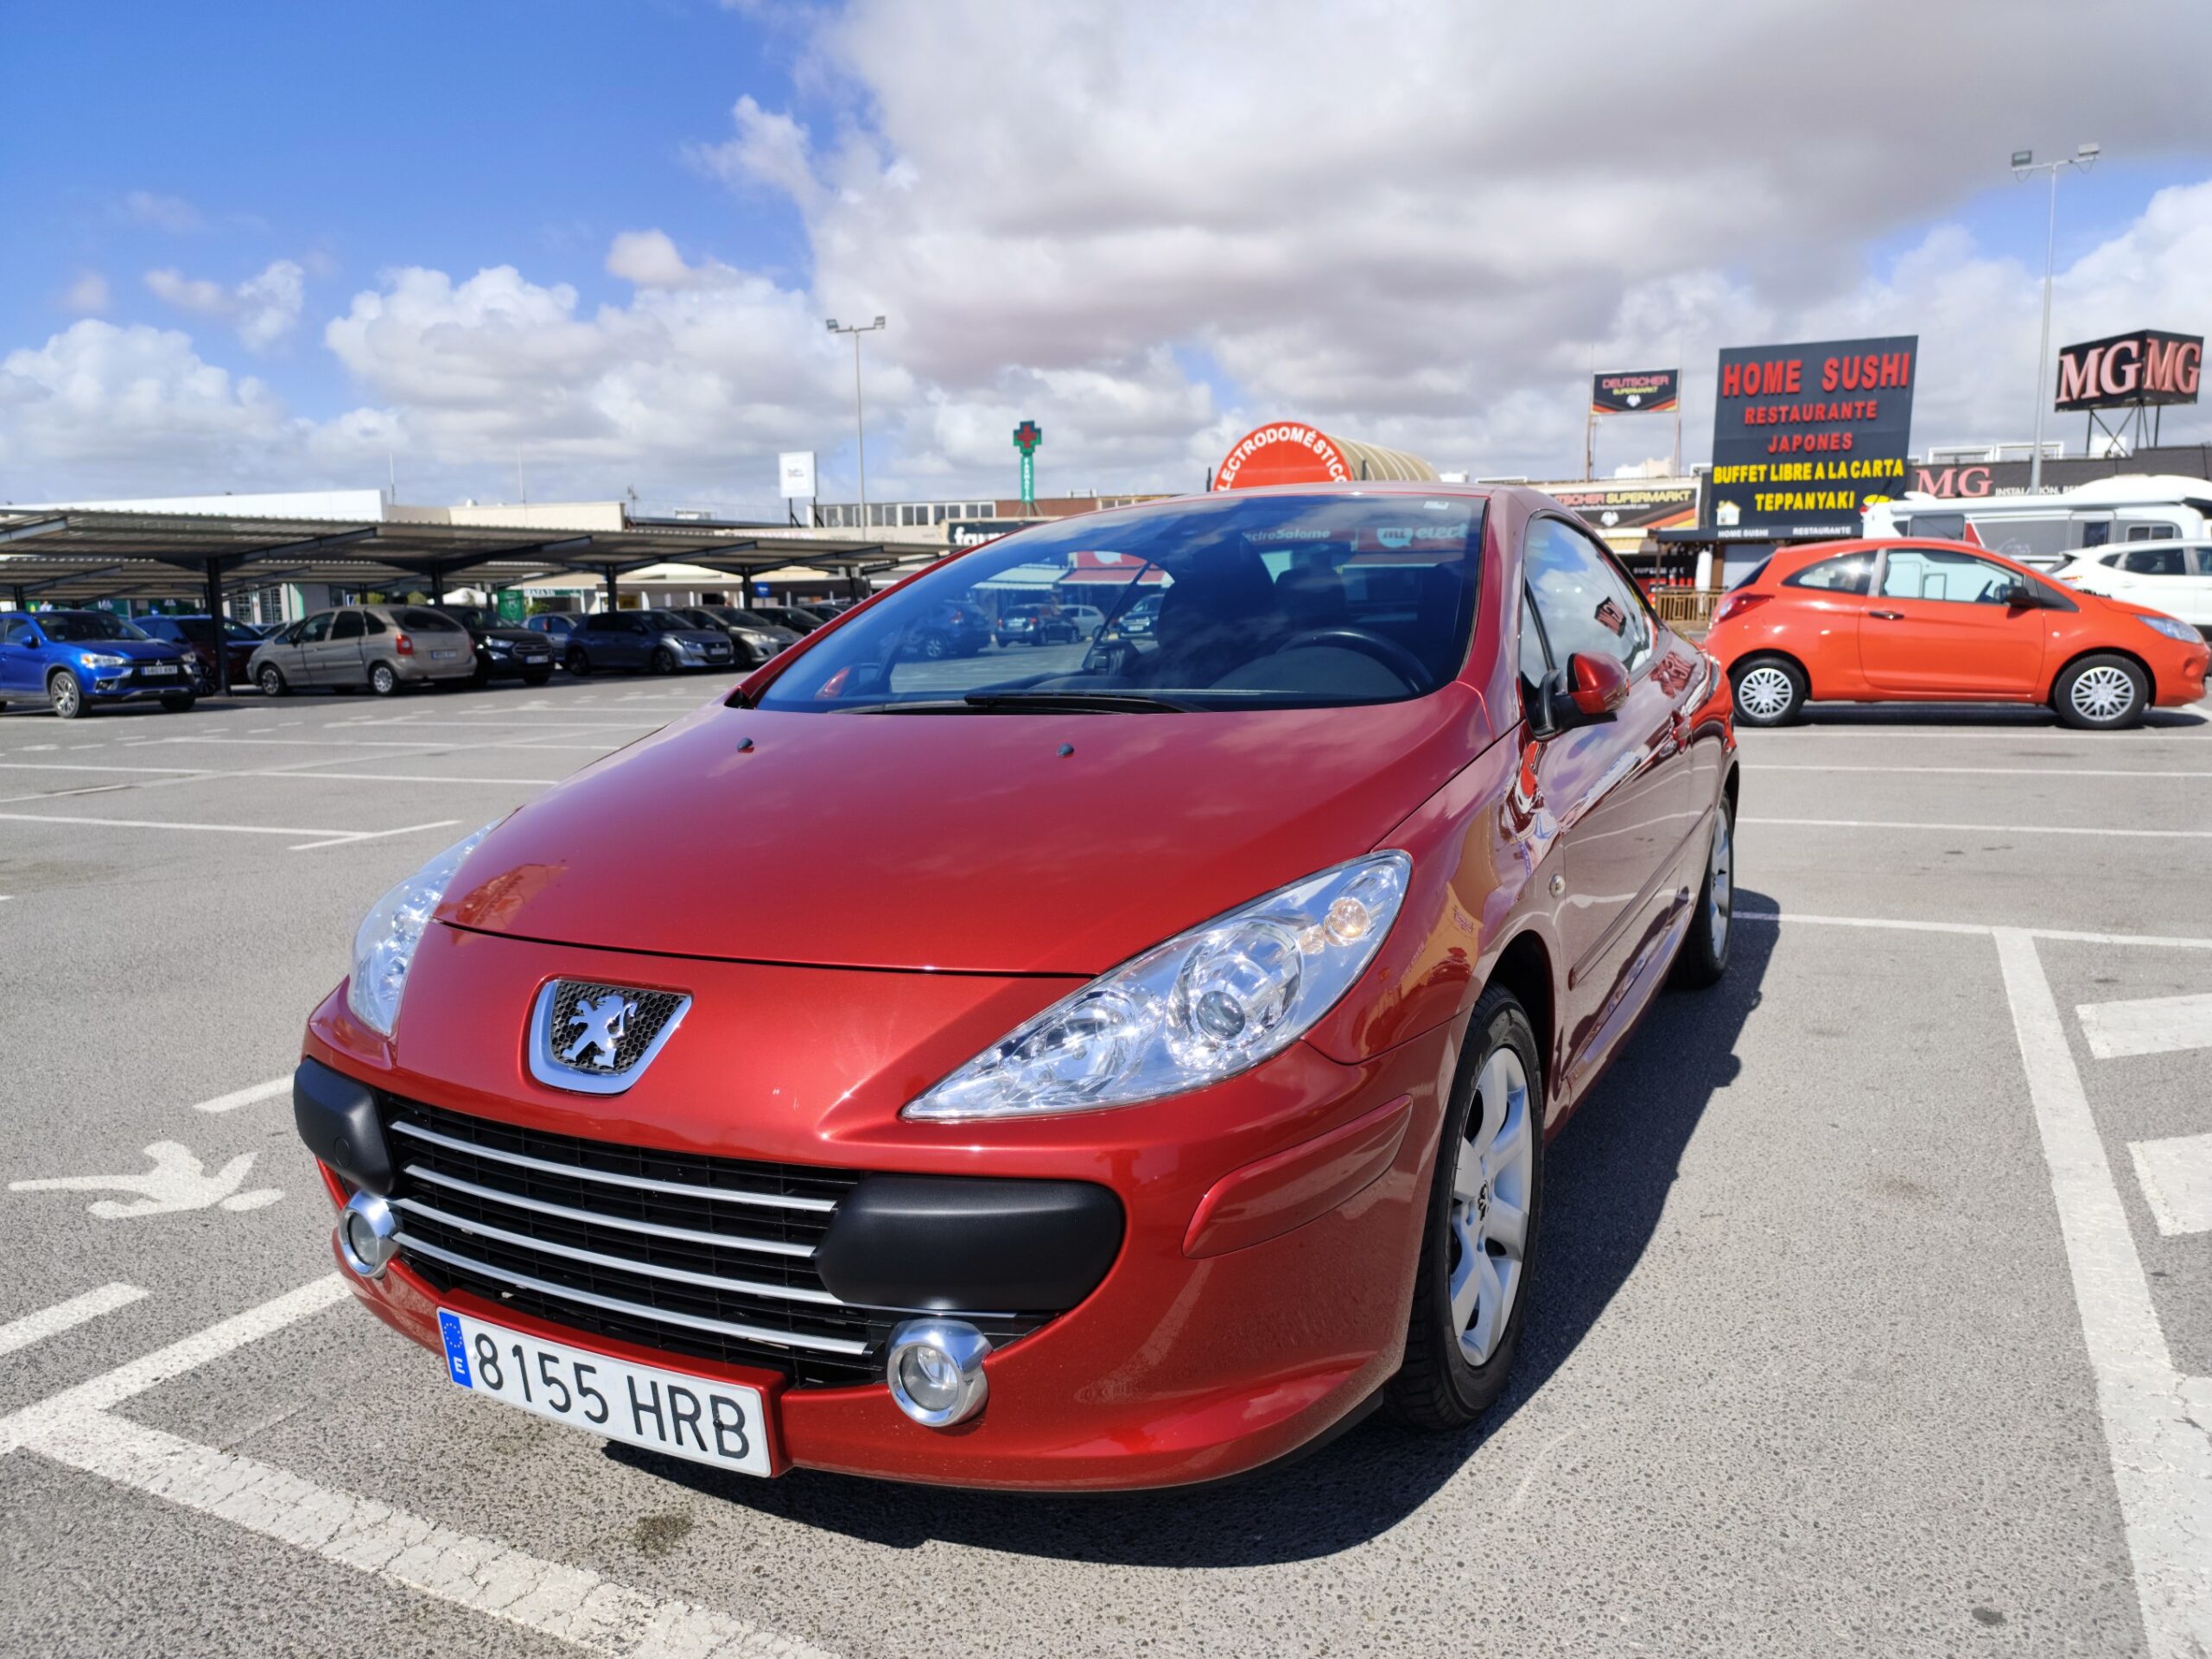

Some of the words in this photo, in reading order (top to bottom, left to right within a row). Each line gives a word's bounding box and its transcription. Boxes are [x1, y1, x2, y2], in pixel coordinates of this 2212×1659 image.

[1722, 359, 1802, 397] HOME
[1821, 353, 1910, 391] SUSHI
[2056, 340, 2142, 404] MG
[2144, 338, 2201, 394] MG
[1602, 375, 1669, 389] DEUTSCHER
[1744, 400, 1878, 425] RESTAURANTE
[1767, 432, 1853, 454] JAPONES
[1217, 426, 1348, 492] LECTRODOMÉSTICO
[1713, 464, 1768, 485] BUFFET
[1770, 461, 1813, 481] LIBRE
[1814, 461, 1826, 480] A
[1827, 461, 1849, 480] LA
[1850, 458, 1904, 480] CARTA
[1915, 467, 1993, 499] MG
[1606, 490, 1691, 505] SUPERMARKT
[1755, 491, 1855, 512] TEPPANYAKI
[1718, 529, 1742, 537] HOME
[1792, 525, 1852, 536] RESTAURANTE
[453, 1357, 466, 1375] E
[474, 1332, 609, 1425] 8155
[626, 1375, 750, 1460] HRB
